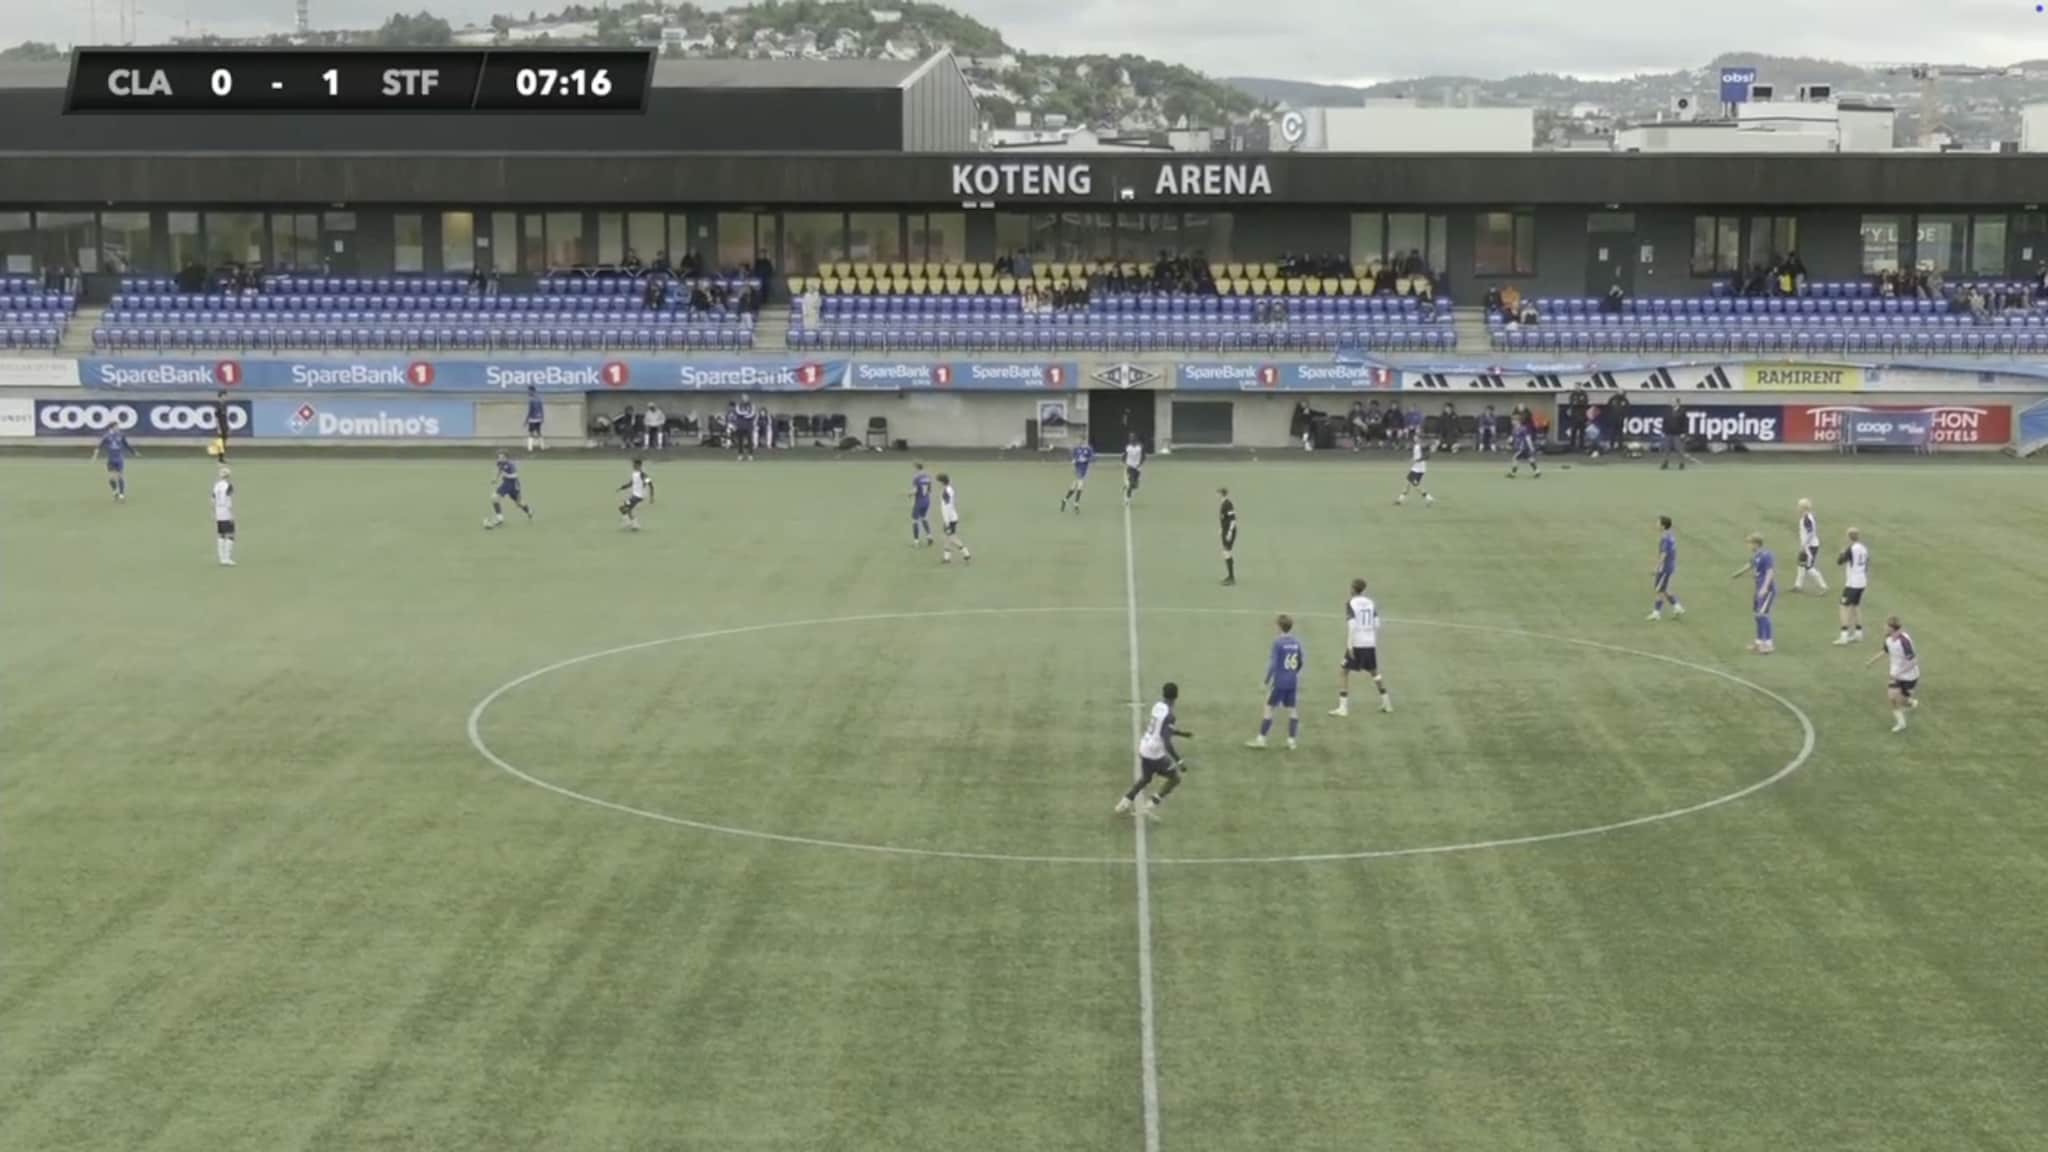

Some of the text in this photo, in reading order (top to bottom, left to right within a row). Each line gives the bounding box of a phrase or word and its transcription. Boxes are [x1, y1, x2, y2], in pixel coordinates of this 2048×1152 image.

[952, 165, 1272, 194] KOTENG ARENA
[101, 364, 213, 387] SpareBank
[291, 365, 405, 387] SpareBank
[486, 365, 600, 388] SpareBank
[681, 366, 795, 388] SpareBank
[859, 364, 931, 380] SpareBank
[972, 365, 1043, 380] SpareBank
[1186, 365, 1256, 380] SpareBank
[1298, 365, 1369, 380] SpareBank
[1757, 370, 1844, 385] RAMIRENT
[319, 411, 440, 435] Domino's
[1685, 411, 1776, 440] Tipping
[1856, 421, 1893, 433] coop
